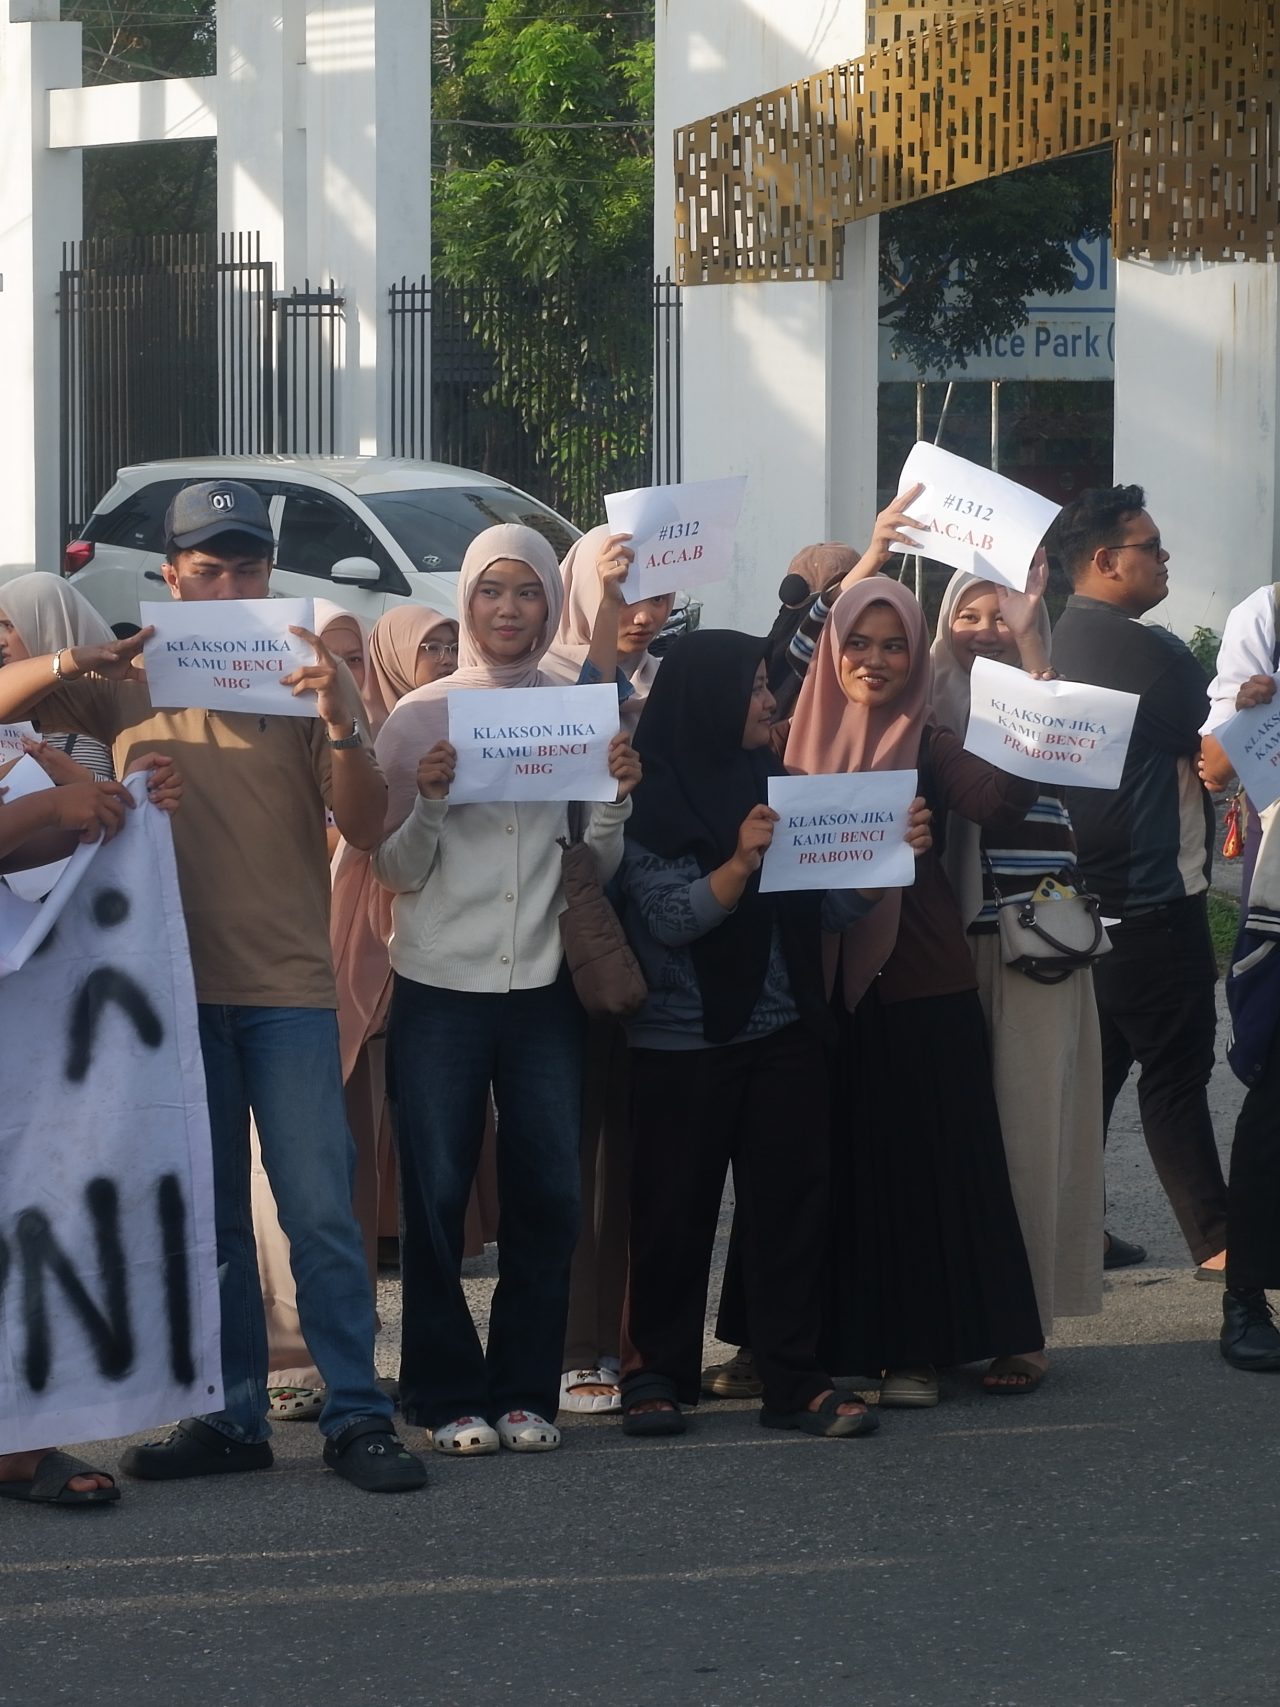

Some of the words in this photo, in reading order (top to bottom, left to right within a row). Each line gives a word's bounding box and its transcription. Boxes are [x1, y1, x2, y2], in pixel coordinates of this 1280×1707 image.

[1035, 326, 1099, 357] Park
[213, 494, 231, 509] 01
[943, 493, 994, 522] #1312
[658, 520, 700, 541] #1312
[928, 517, 995, 551] A.C.A.B
[646, 545, 704, 569] A.C.A.B
[167, 640, 247, 653] KLAKSON
[251, 639, 291, 652] JIKA
[177, 657, 227, 671] KAMU
[232, 659, 283, 672] BENCI
[213, 676, 250, 690] MBG
[991, 698, 1066, 729] KLAKSON
[1069, 719, 1107, 735] JIKA
[473, 725, 553, 740] KLAKSON
[557, 723, 596, 737] JIKA
[998, 715, 1041, 742] KAMU
[1045, 733, 1097, 750] BENCI
[1244, 710, 1280, 754] KLAKS
[482, 746, 533, 759] KAMU
[537, 743, 588, 757] BENCI
[1003, 734, 1083, 764] PRABOWO
[515, 763, 553, 775] MBG
[789, 814, 858, 828] KLAKSON
[861, 811, 895, 824] JIKA
[793, 832, 837, 846] KAMU
[840, 830, 885, 843] BENCI
[799, 849, 874, 864] PRABOWO
